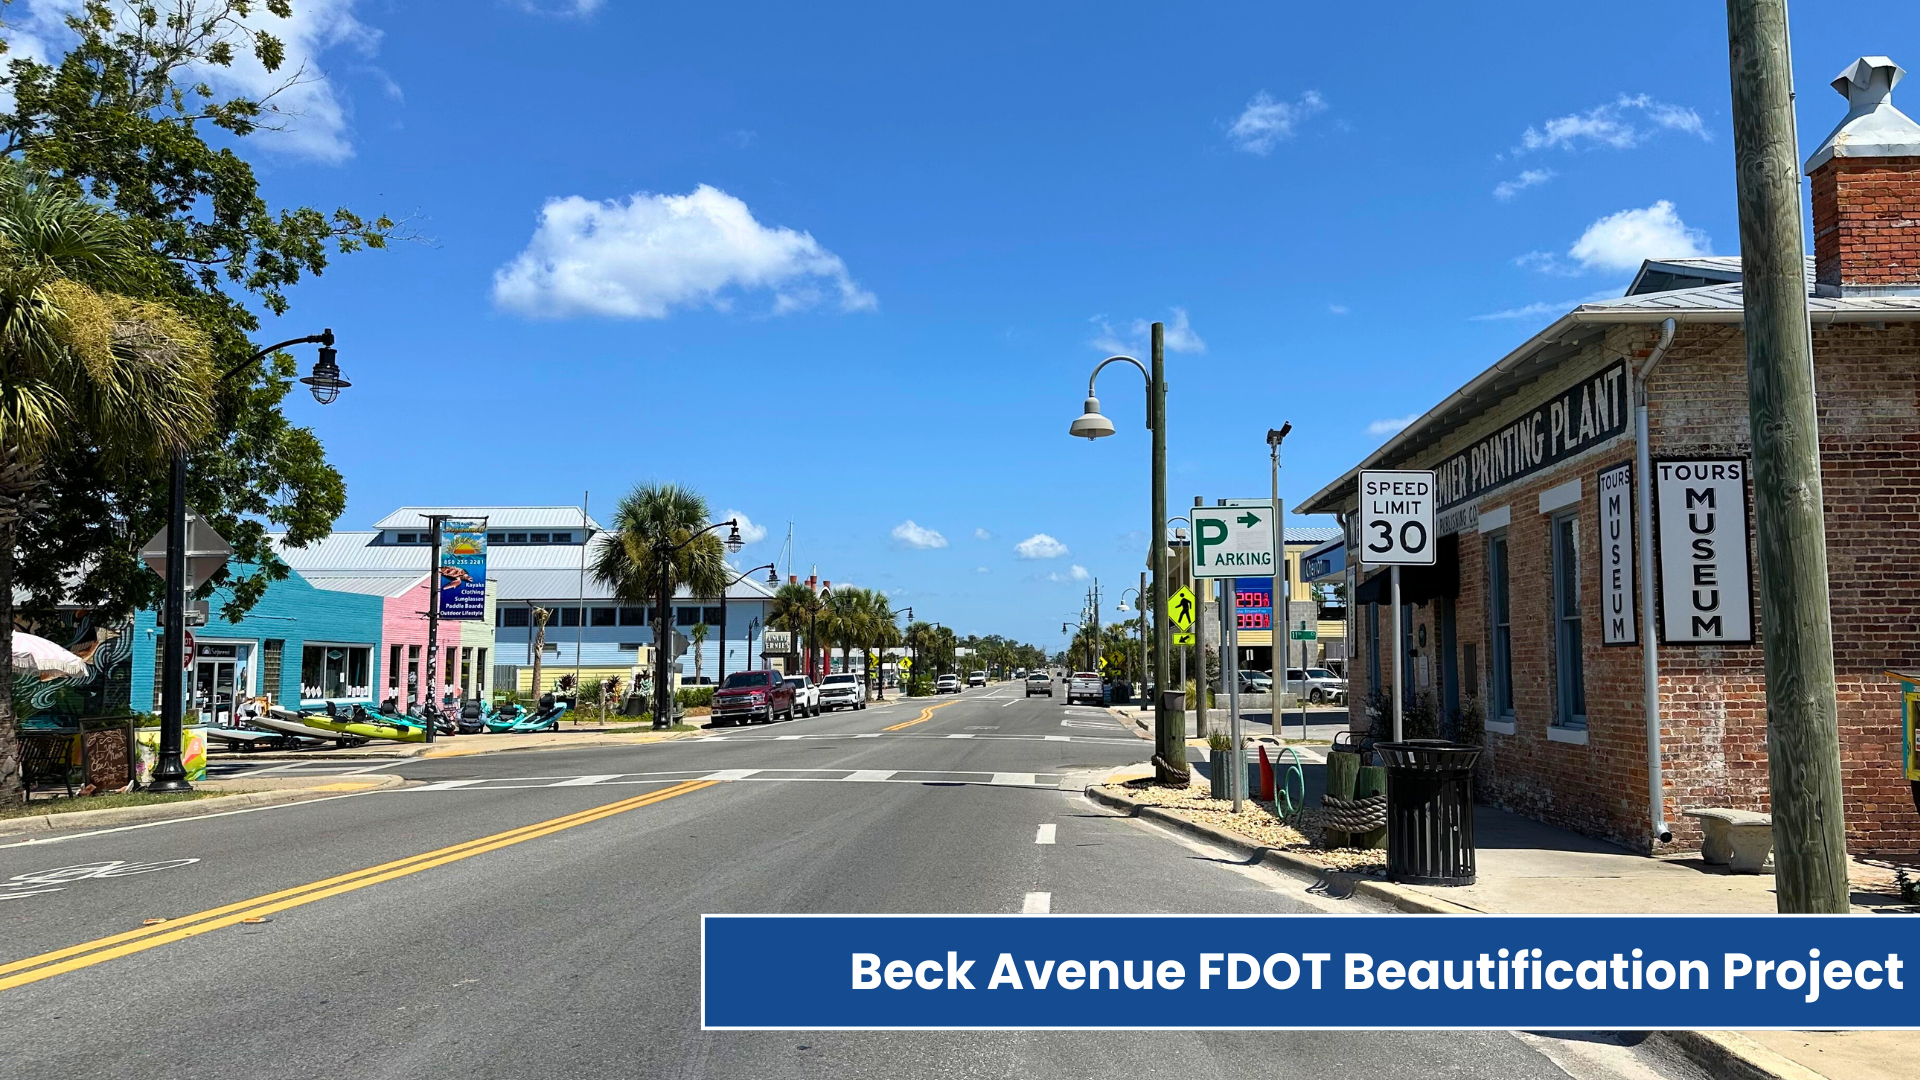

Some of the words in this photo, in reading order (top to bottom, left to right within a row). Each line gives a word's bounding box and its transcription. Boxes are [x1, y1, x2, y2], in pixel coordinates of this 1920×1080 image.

[1436, 455, 1467, 508] EMIER
[1471, 411, 1545, 492] PRINTING
[1550, 365, 1622, 456] PLANT
[1601, 469, 1630, 492] TOURS
[1659, 464, 1740, 481] TOURS
[1366, 481, 1428, 496] SPEED
[1373, 501, 1422, 515] LIMIT
[1367, 519, 1427, 554] 30
[1609, 494, 1625, 640] MUSEUM
[1685, 487, 1723, 638] MUSEUM
